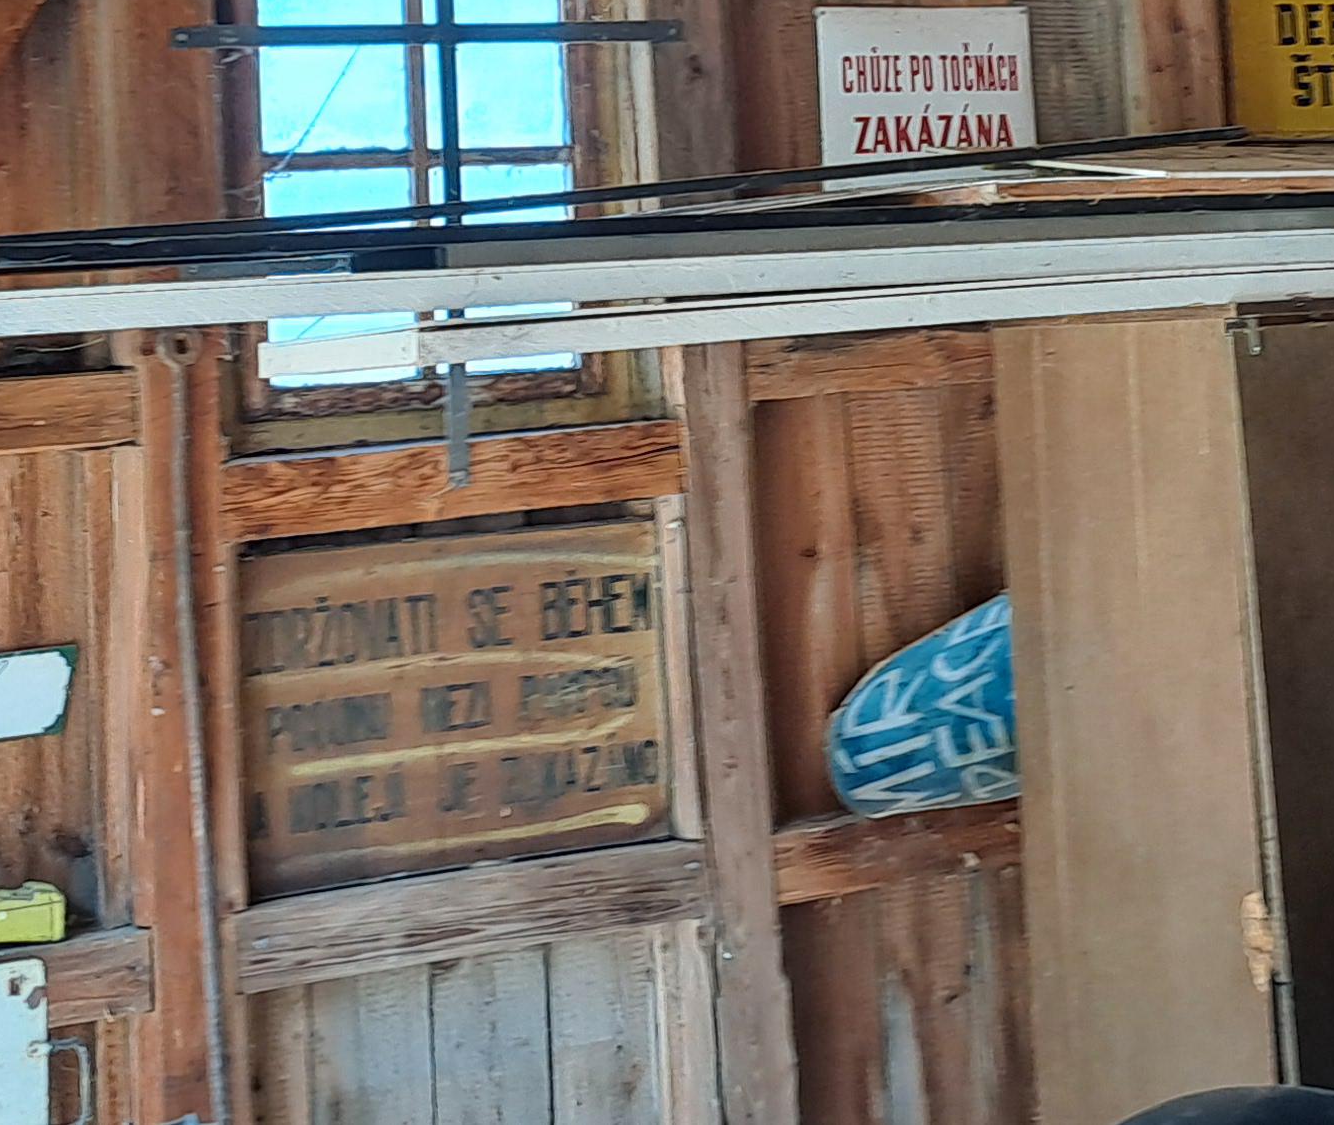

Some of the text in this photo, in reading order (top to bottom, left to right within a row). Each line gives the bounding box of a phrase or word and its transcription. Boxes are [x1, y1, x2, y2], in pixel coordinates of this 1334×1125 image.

[841, 42, 1020, 94] CHŮZE PO TOČNÁCH
[852, 103, 1016, 156] ZAKÁZÁNA
[468, 584, 514, 649] SE
